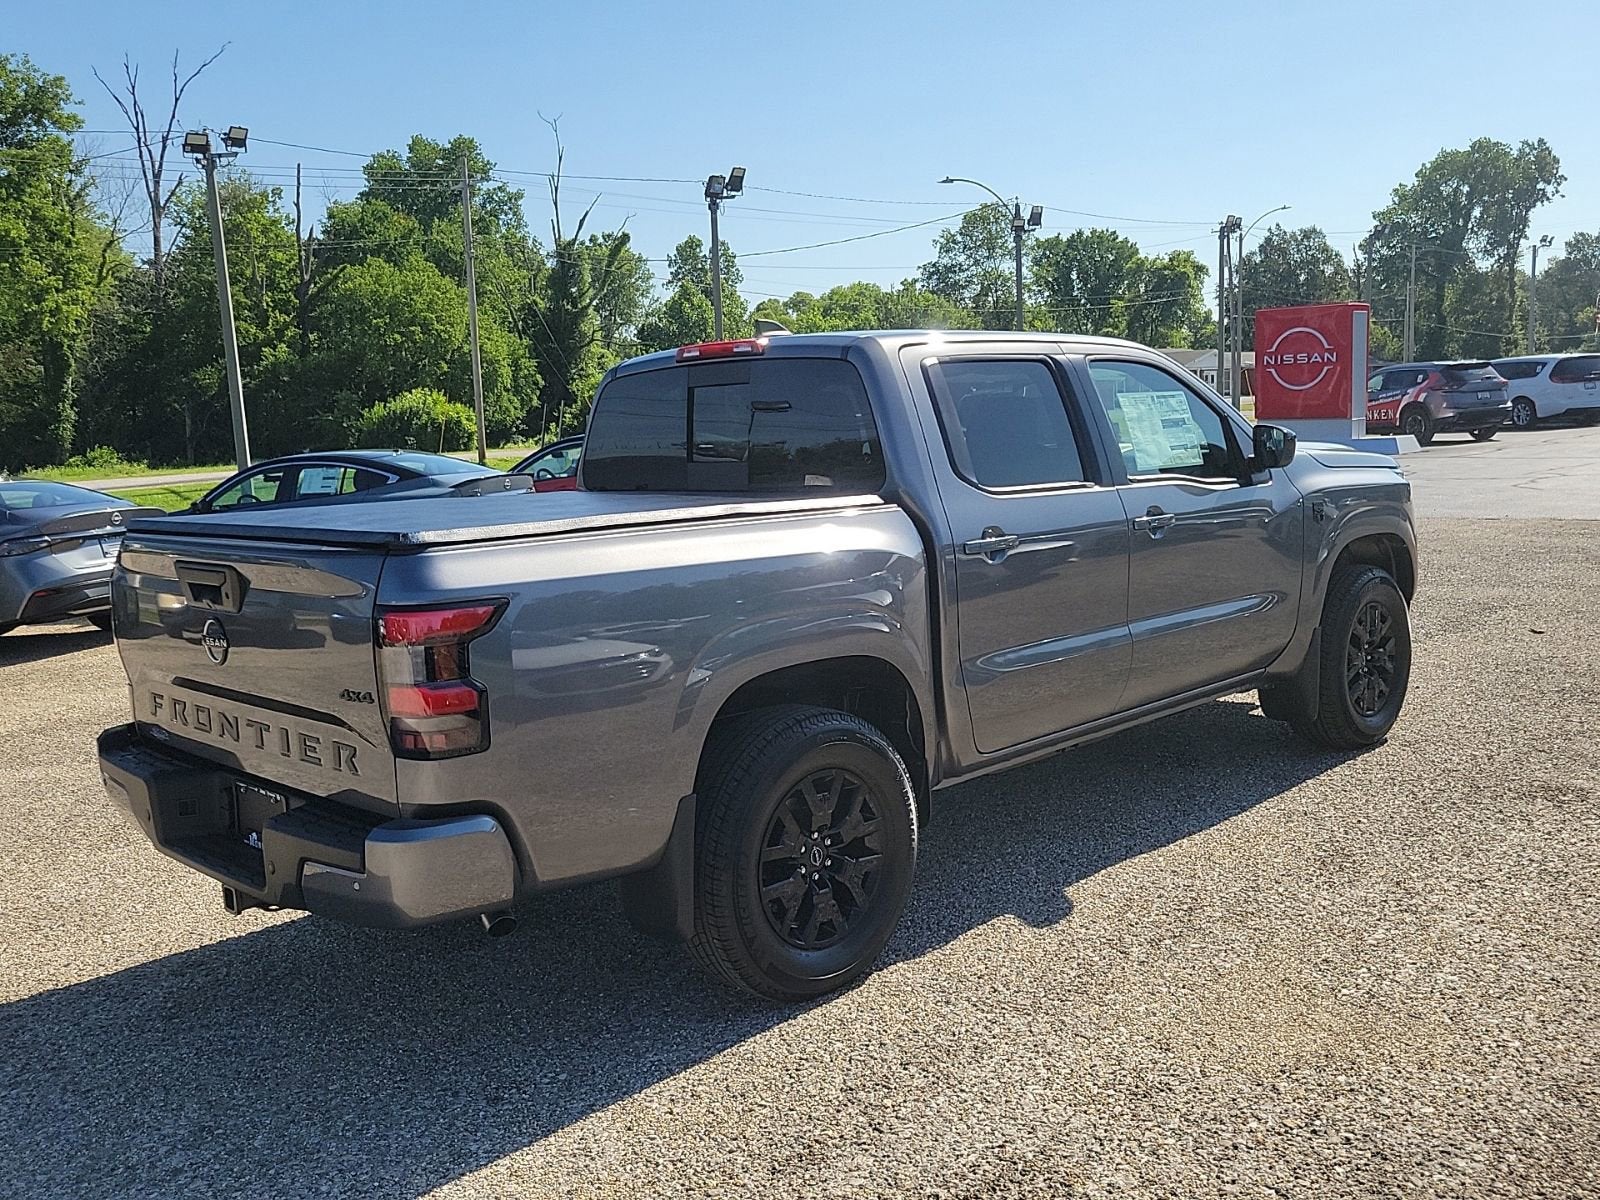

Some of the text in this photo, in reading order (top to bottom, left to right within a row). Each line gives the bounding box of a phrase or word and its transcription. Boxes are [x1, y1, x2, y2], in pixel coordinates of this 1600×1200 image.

[1263, 351, 1337, 366] NISSAN
[202, 636, 228, 649] SSAN
[150, 691, 361, 776] FRONTIER
